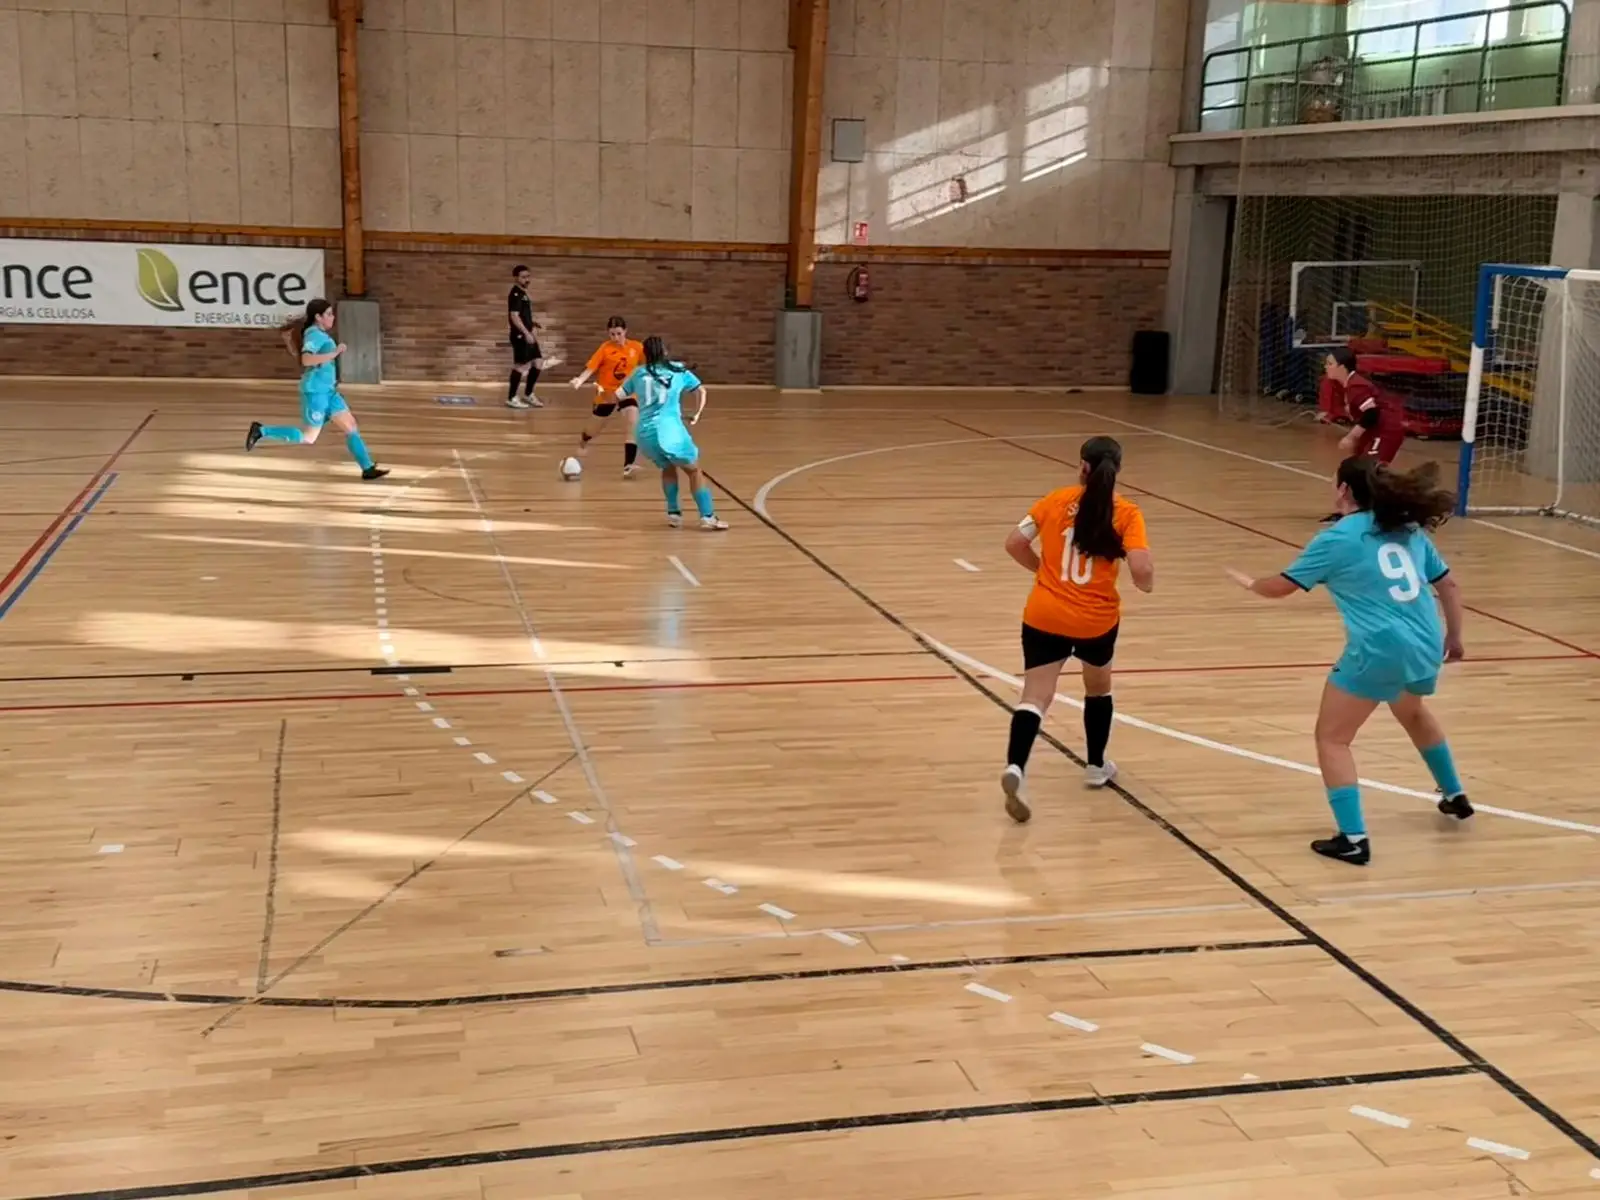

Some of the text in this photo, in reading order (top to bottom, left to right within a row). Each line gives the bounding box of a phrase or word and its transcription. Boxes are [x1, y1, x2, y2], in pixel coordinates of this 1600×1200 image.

[188, 270, 307, 306] ence
[26, 307, 35, 318] &
[36, 307, 96, 319] CELULOSA
[243, 312, 252, 325] &
[1060, 527, 1094, 585] 10
[1377, 542, 1420, 602] 9
